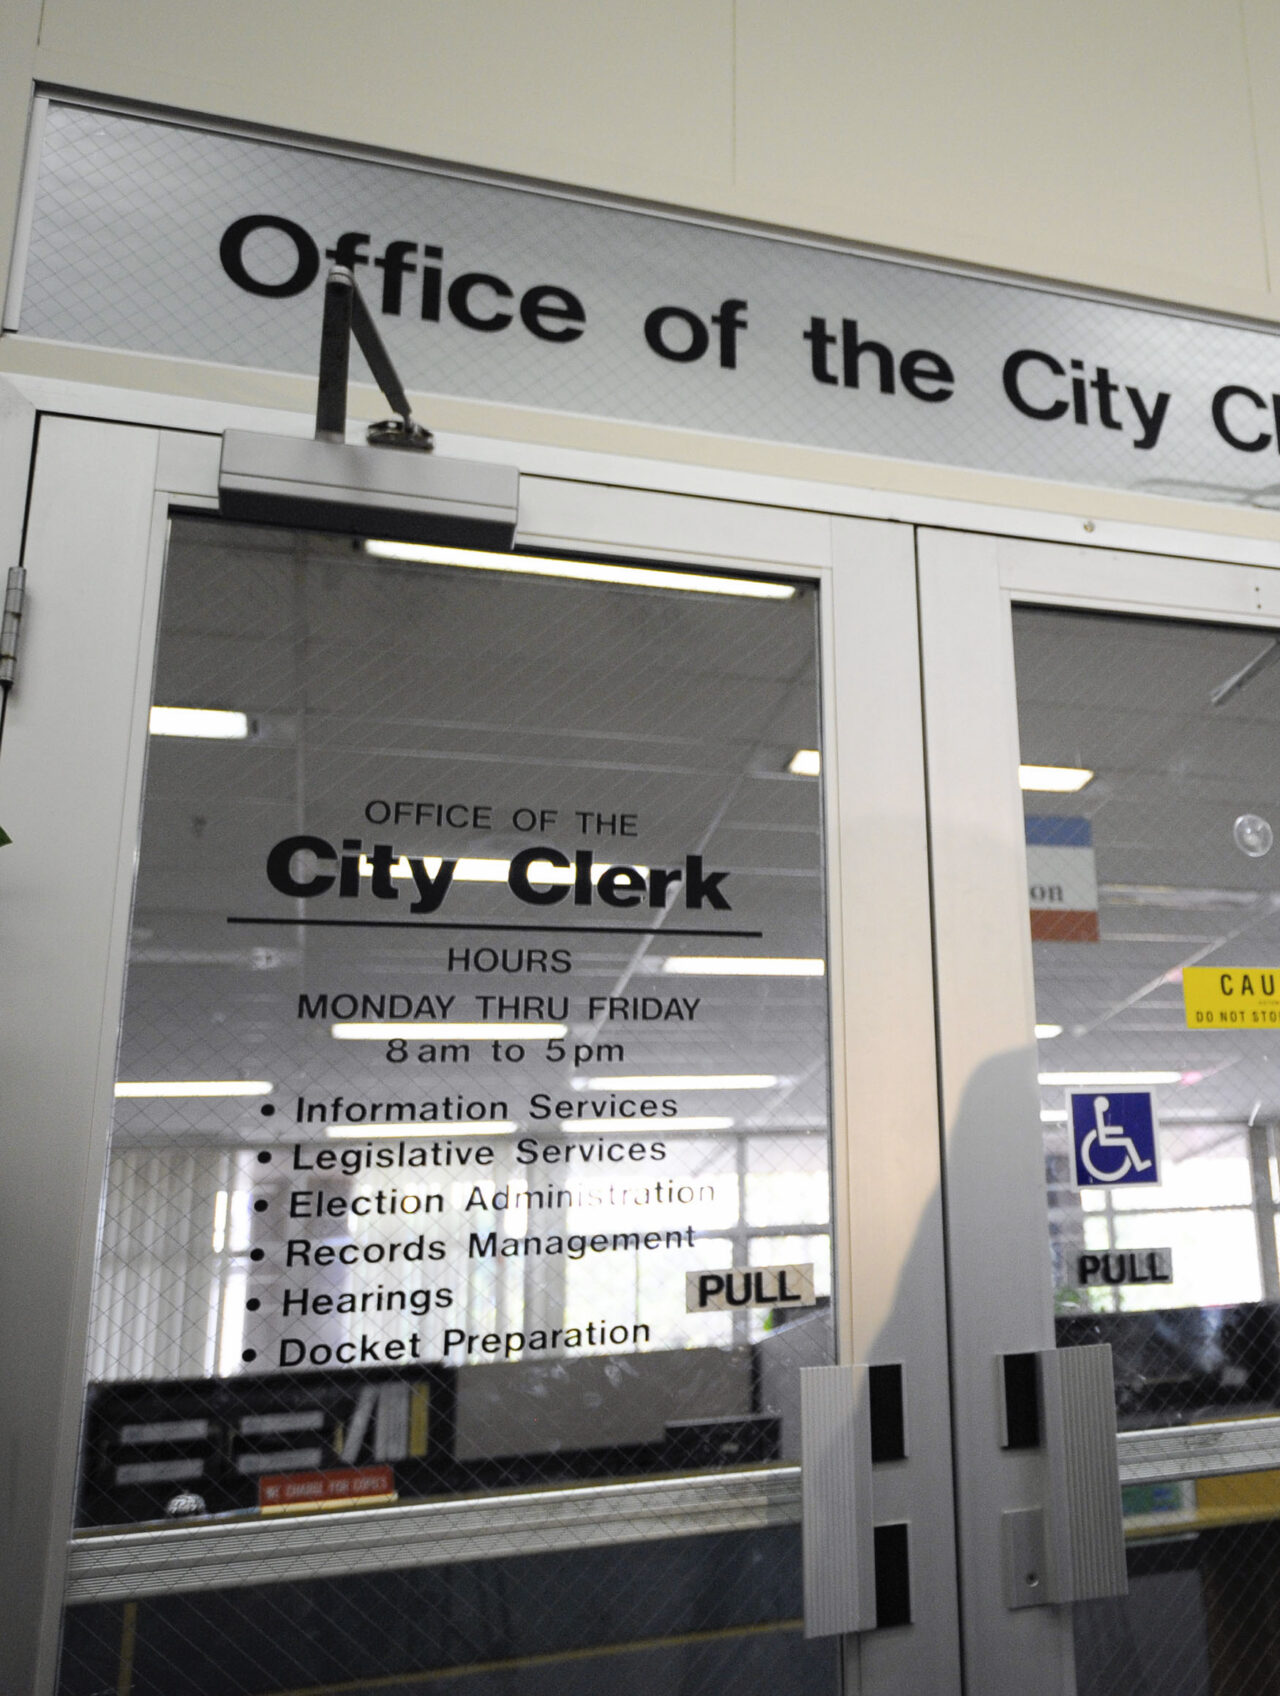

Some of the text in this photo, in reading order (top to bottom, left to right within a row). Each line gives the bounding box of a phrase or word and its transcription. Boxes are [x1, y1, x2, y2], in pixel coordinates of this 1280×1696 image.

[219, 214, 586, 344] Office
[643, 298, 748, 370] of
[803, 317, 955, 402] the
[1001, 349, 1170, 450] City
[364, 800, 638, 836] OFFICE OF THE
[266, 834, 731, 915] City Clerk
[448, 948, 572, 974] HOURS
[298, 994, 700, 1022] MONDAY THRU FRIDAY
[1196, 1011, 1213, 1023] DO
[1220, 1011, 1245, 1023] NOT
[492, 1040, 525, 1064] to
[296, 1092, 678, 1124] Information Services
[292, 1138, 666, 1175] Legislative Services
[290, 1179, 716, 1219] Election Administration
[286, 1224, 696, 1268] Records Management
[1078, 1254, 1169, 1285] PULL
[282, 1282, 454, 1319] Hearings
[699, 1273, 800, 1308] PULL
[279, 1319, 651, 1369] Docket Preparation
